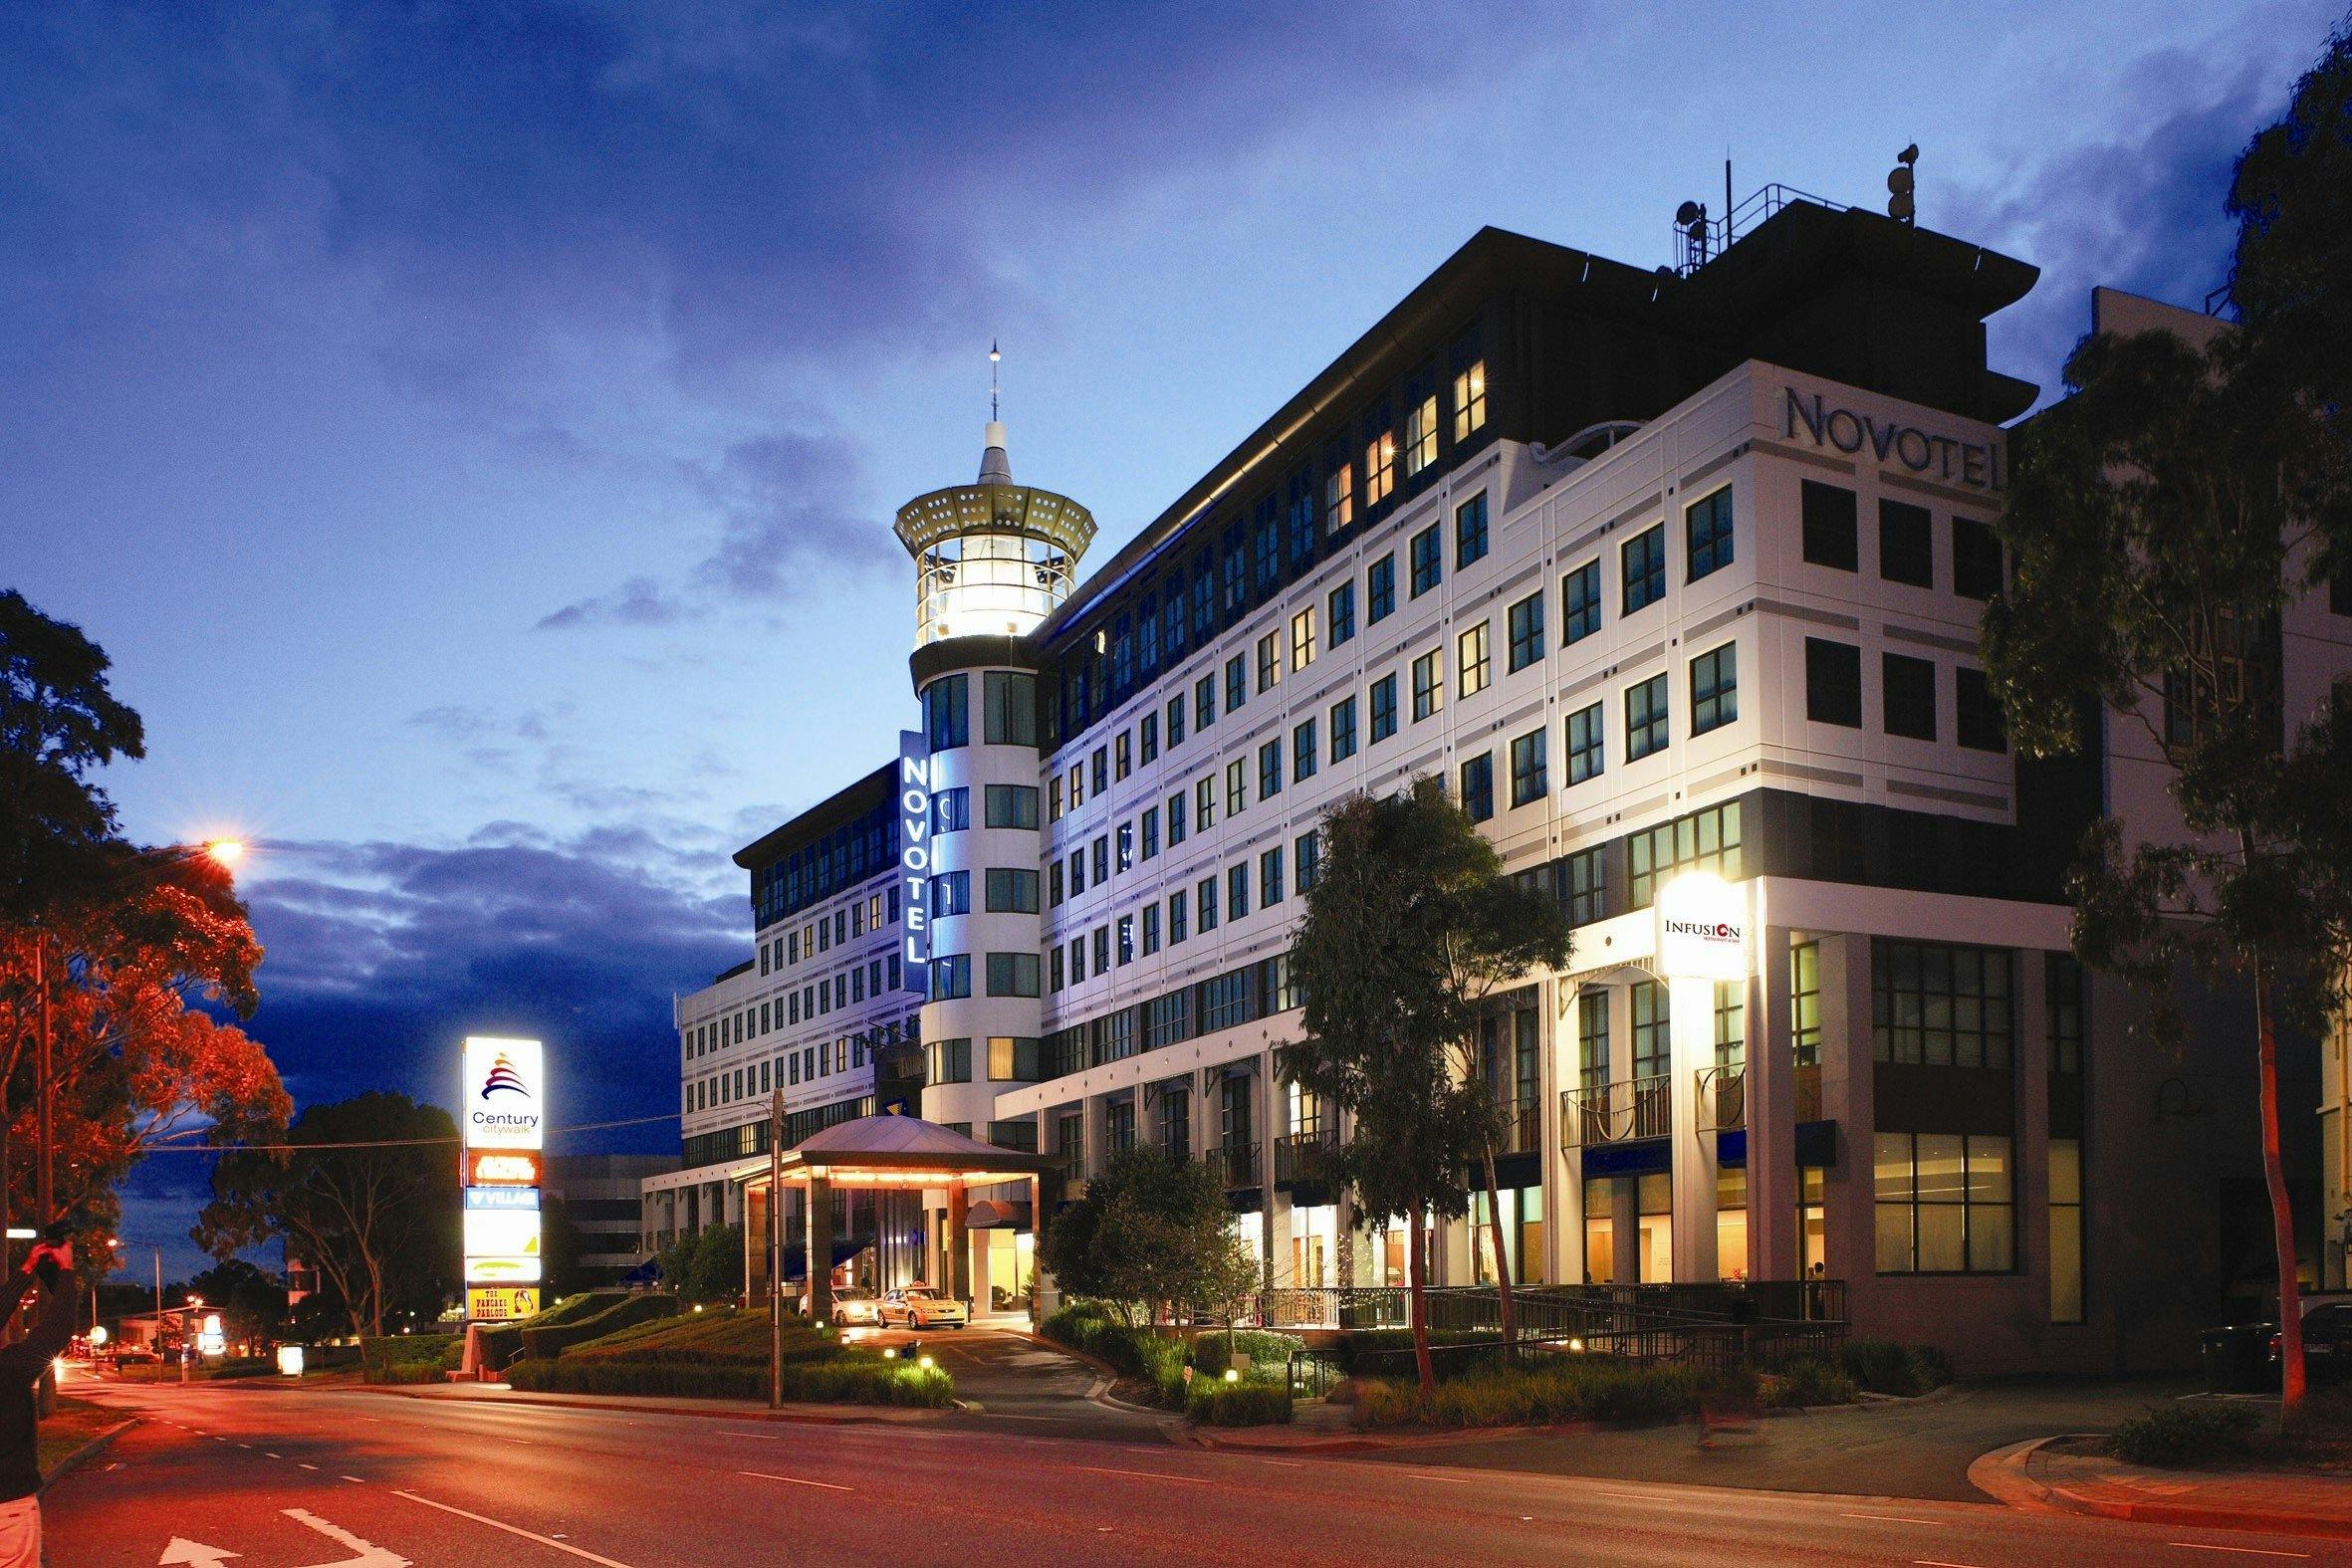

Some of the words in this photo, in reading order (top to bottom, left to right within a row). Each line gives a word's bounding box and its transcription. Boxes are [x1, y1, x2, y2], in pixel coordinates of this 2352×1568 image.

[1784, 387, 2006, 491] NOVOTEL
[903, 757, 928, 964] NOVOTEL
[1666, 920, 1740, 938] INFUSION
[473, 1112, 539, 1128] Century
[476, 1298, 508, 1307] PANCAKE
[476, 1308, 508, 1318] PARLOUR
